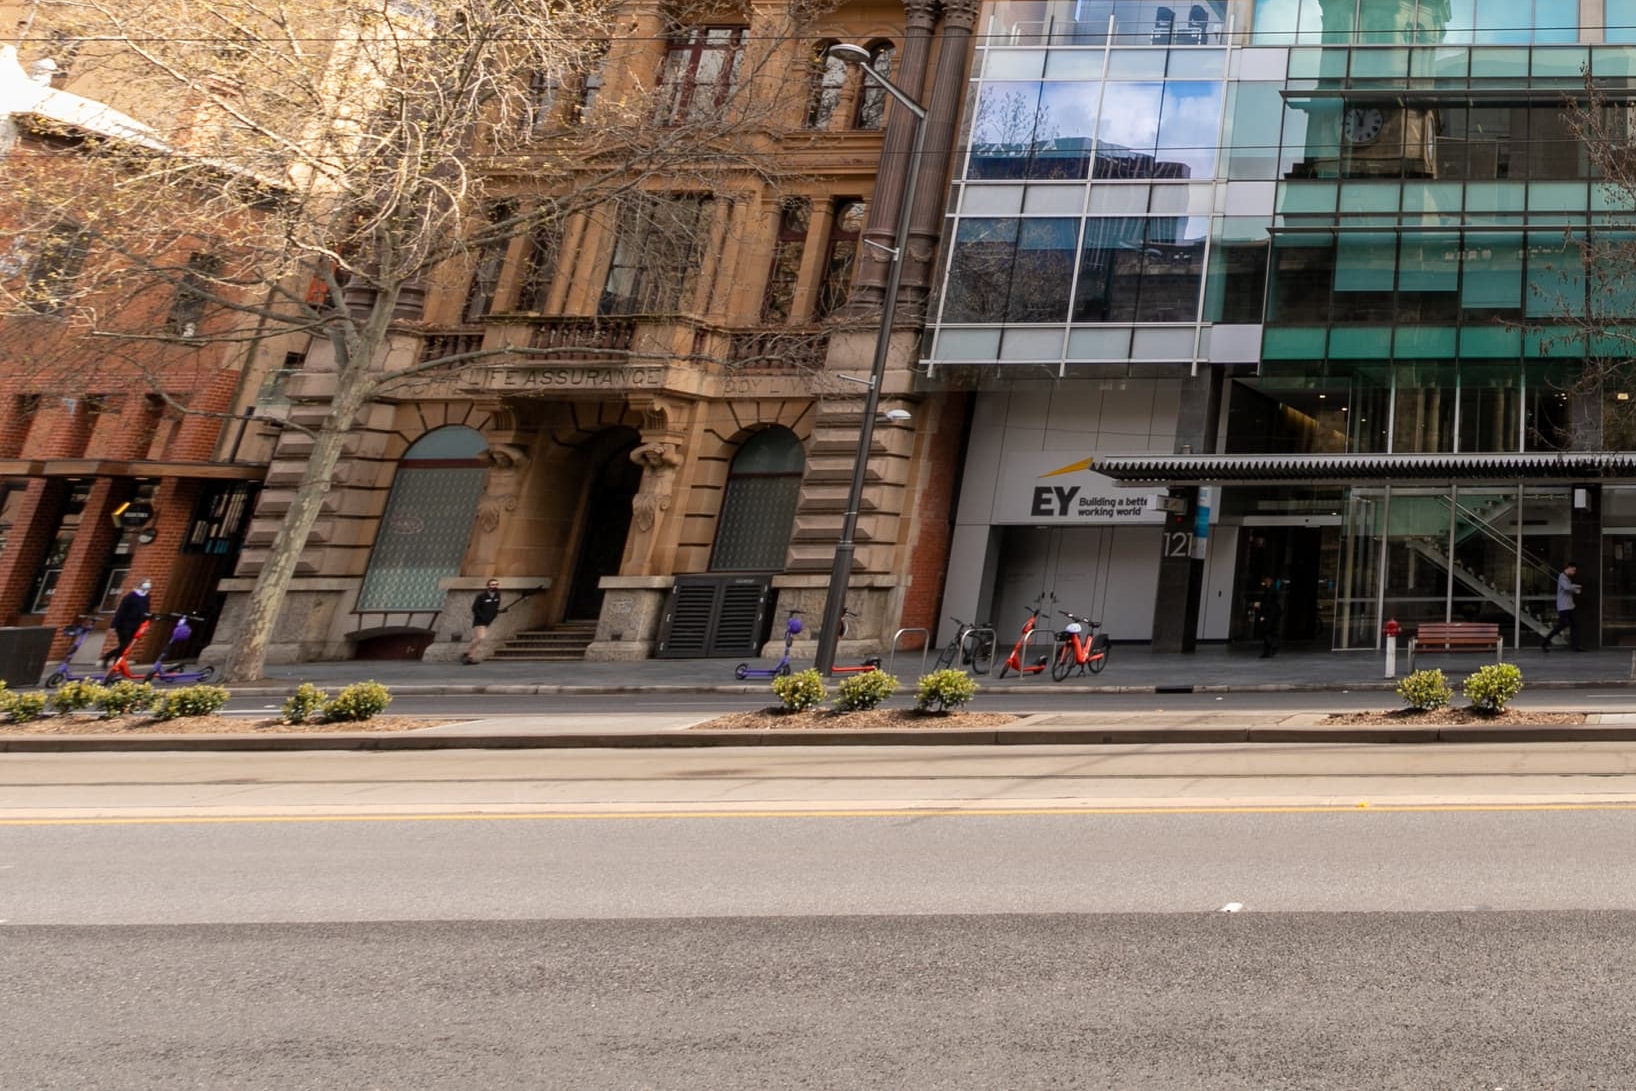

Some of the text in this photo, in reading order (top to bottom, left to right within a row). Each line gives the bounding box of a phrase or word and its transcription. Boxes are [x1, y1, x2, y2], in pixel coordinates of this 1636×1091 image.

[468, 369, 665, 386] LIFE ASSURANCE
[1031, 486, 1081, 516] EY
[1079, 497, 1116, 510] Building
[1078, 506, 1142, 518] working world
[1164, 532, 1194, 557] 121
